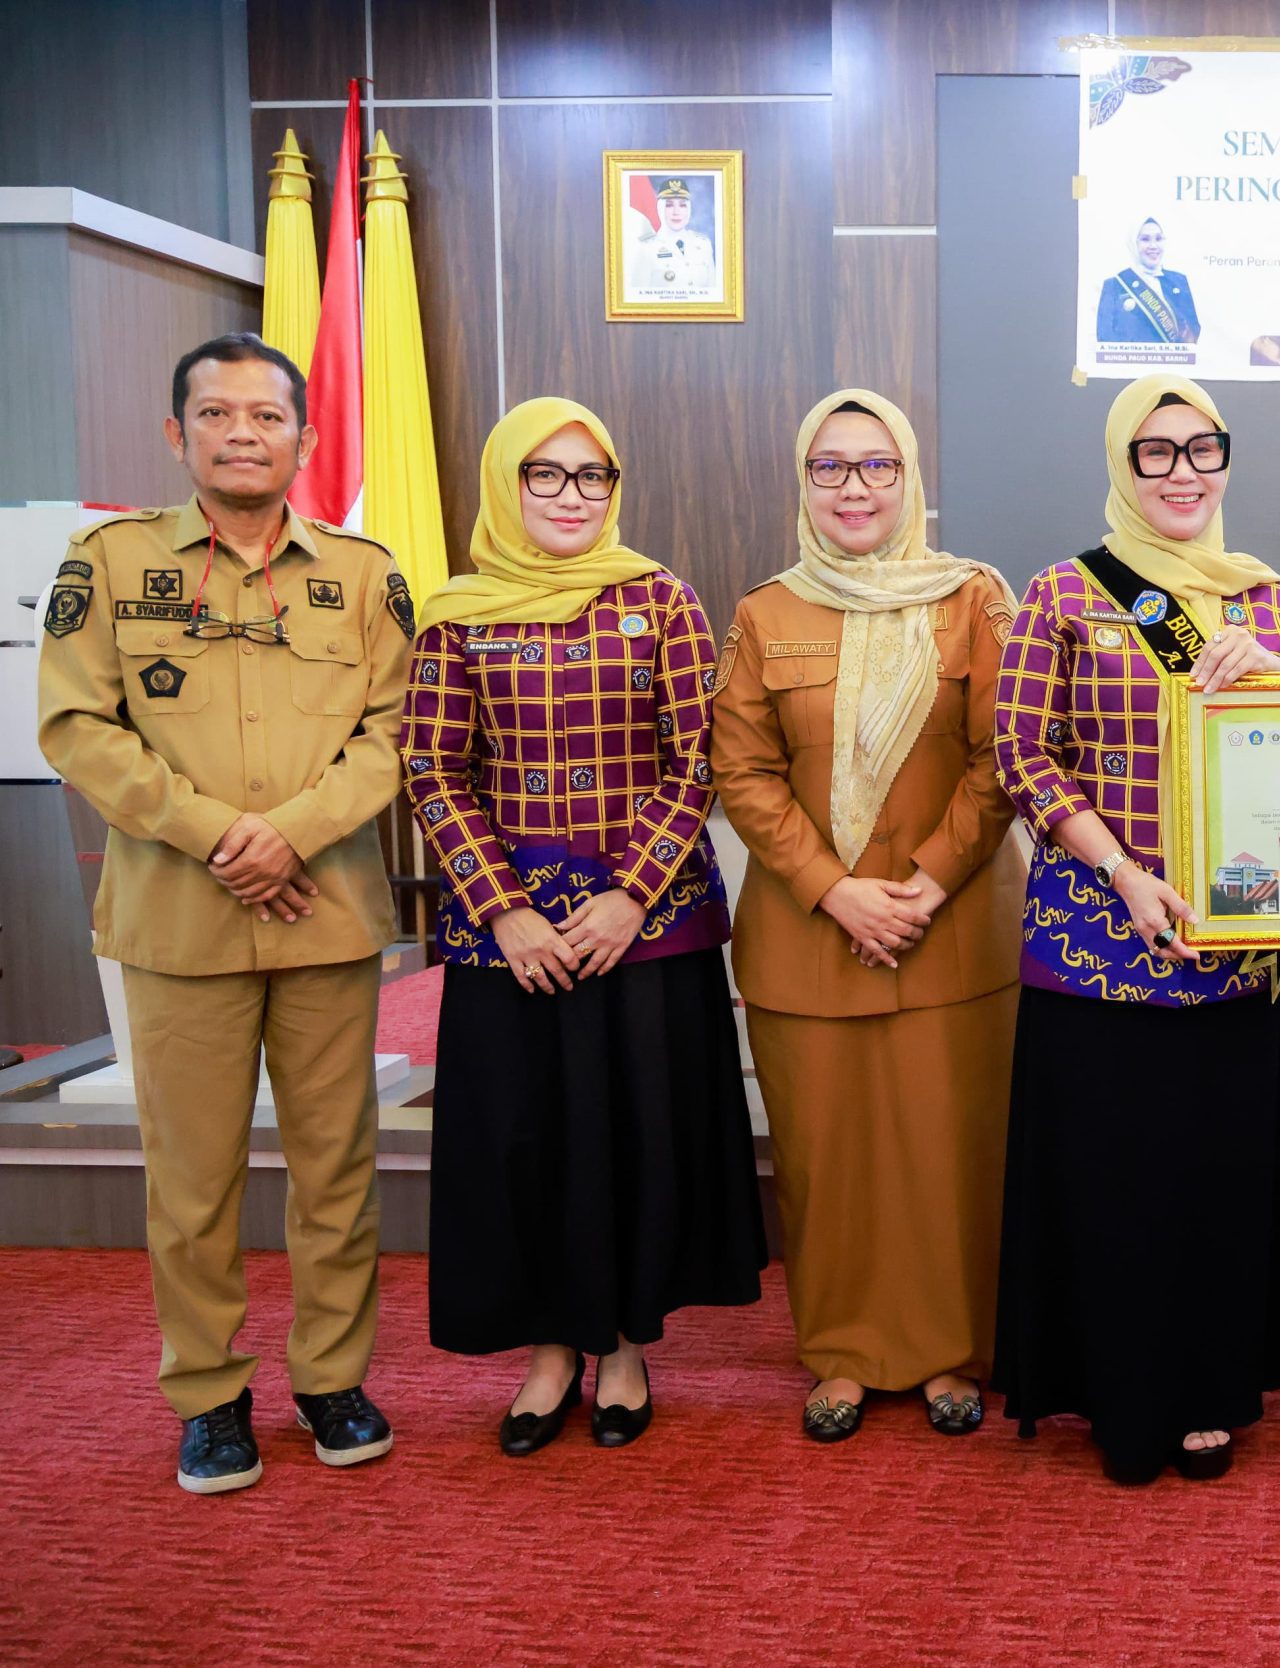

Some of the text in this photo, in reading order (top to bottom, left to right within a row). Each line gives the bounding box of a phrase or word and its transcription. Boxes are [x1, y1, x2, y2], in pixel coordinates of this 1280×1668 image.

[121, 604, 196, 618] A. SYARIFUDD
[1165, 614, 1203, 662] BUND
[771, 644, 832, 655] MILAWATY
